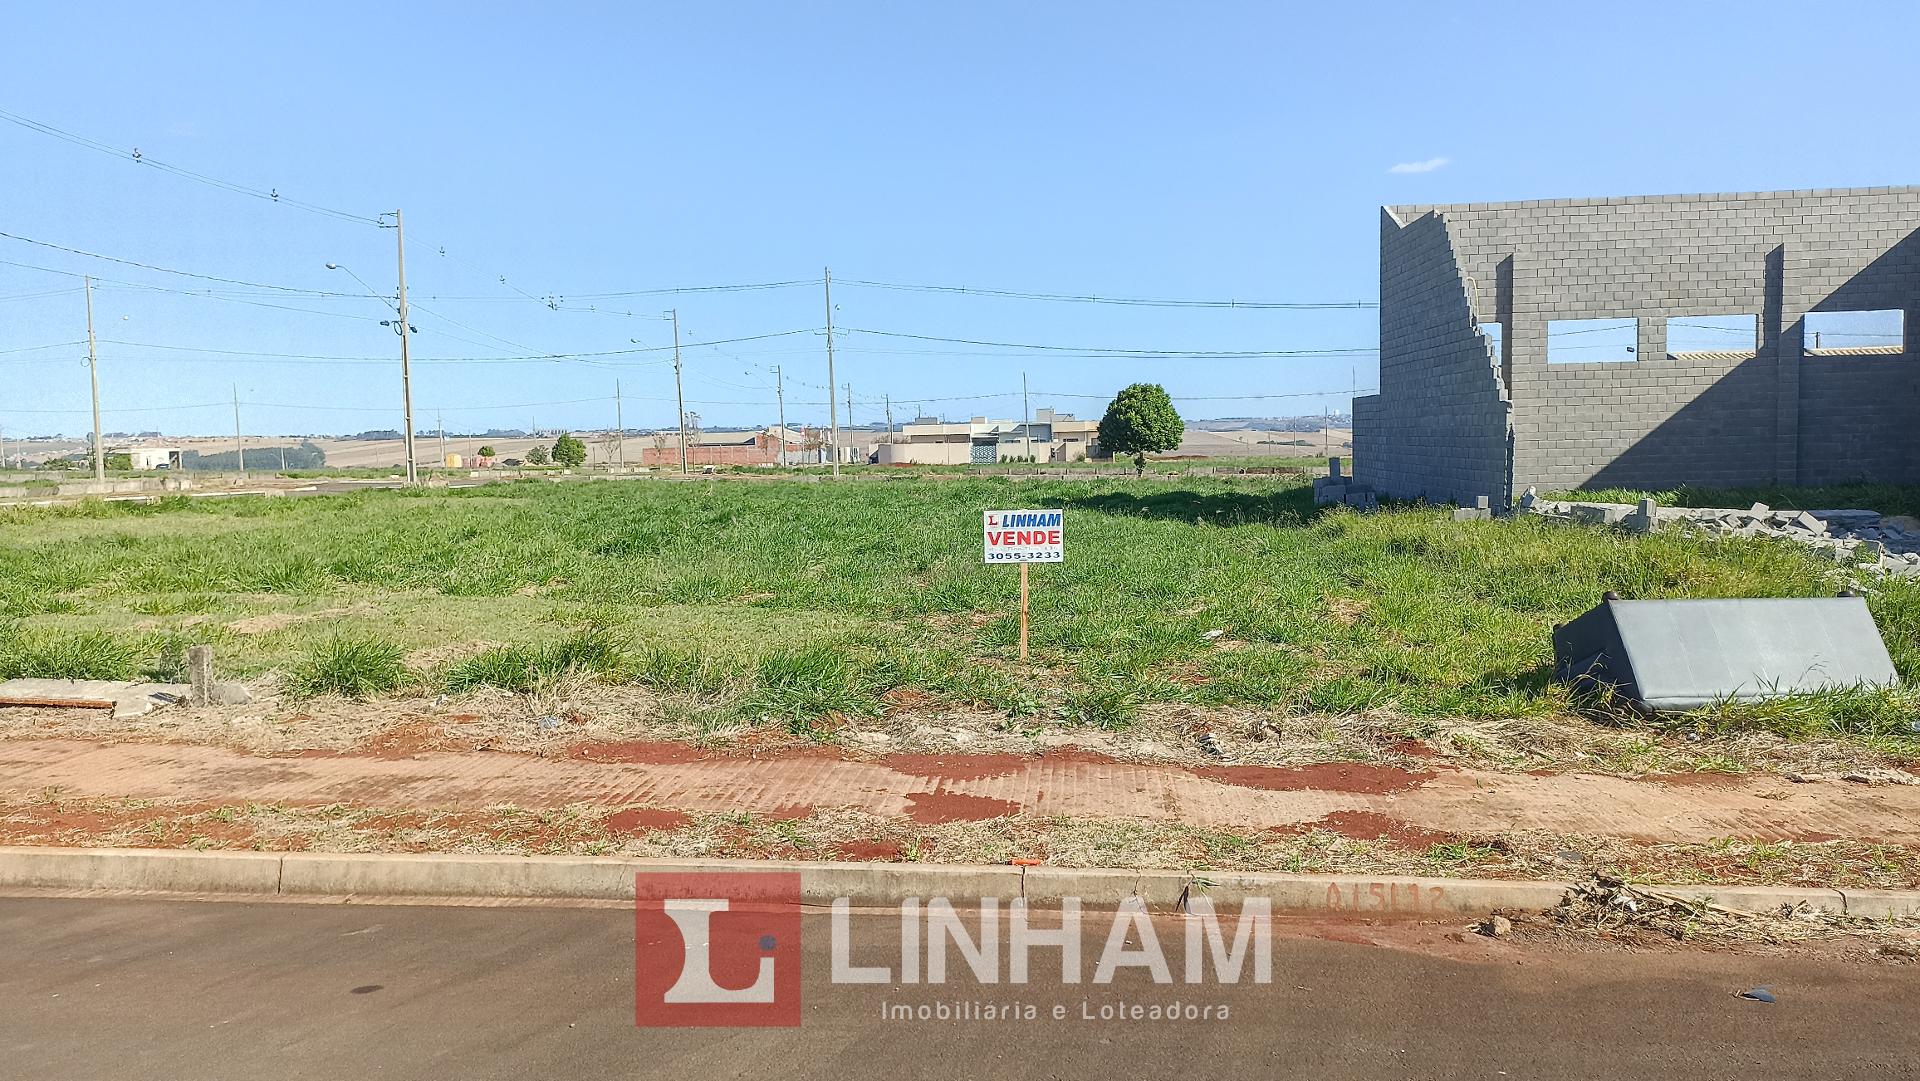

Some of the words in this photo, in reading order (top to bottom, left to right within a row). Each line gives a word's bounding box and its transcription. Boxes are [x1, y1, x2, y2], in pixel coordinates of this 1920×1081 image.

[1002, 513, 1061, 528] LINHAM
[987, 530, 1061, 546] VENDE
[987, 551, 1061, 560] 3055-3233
